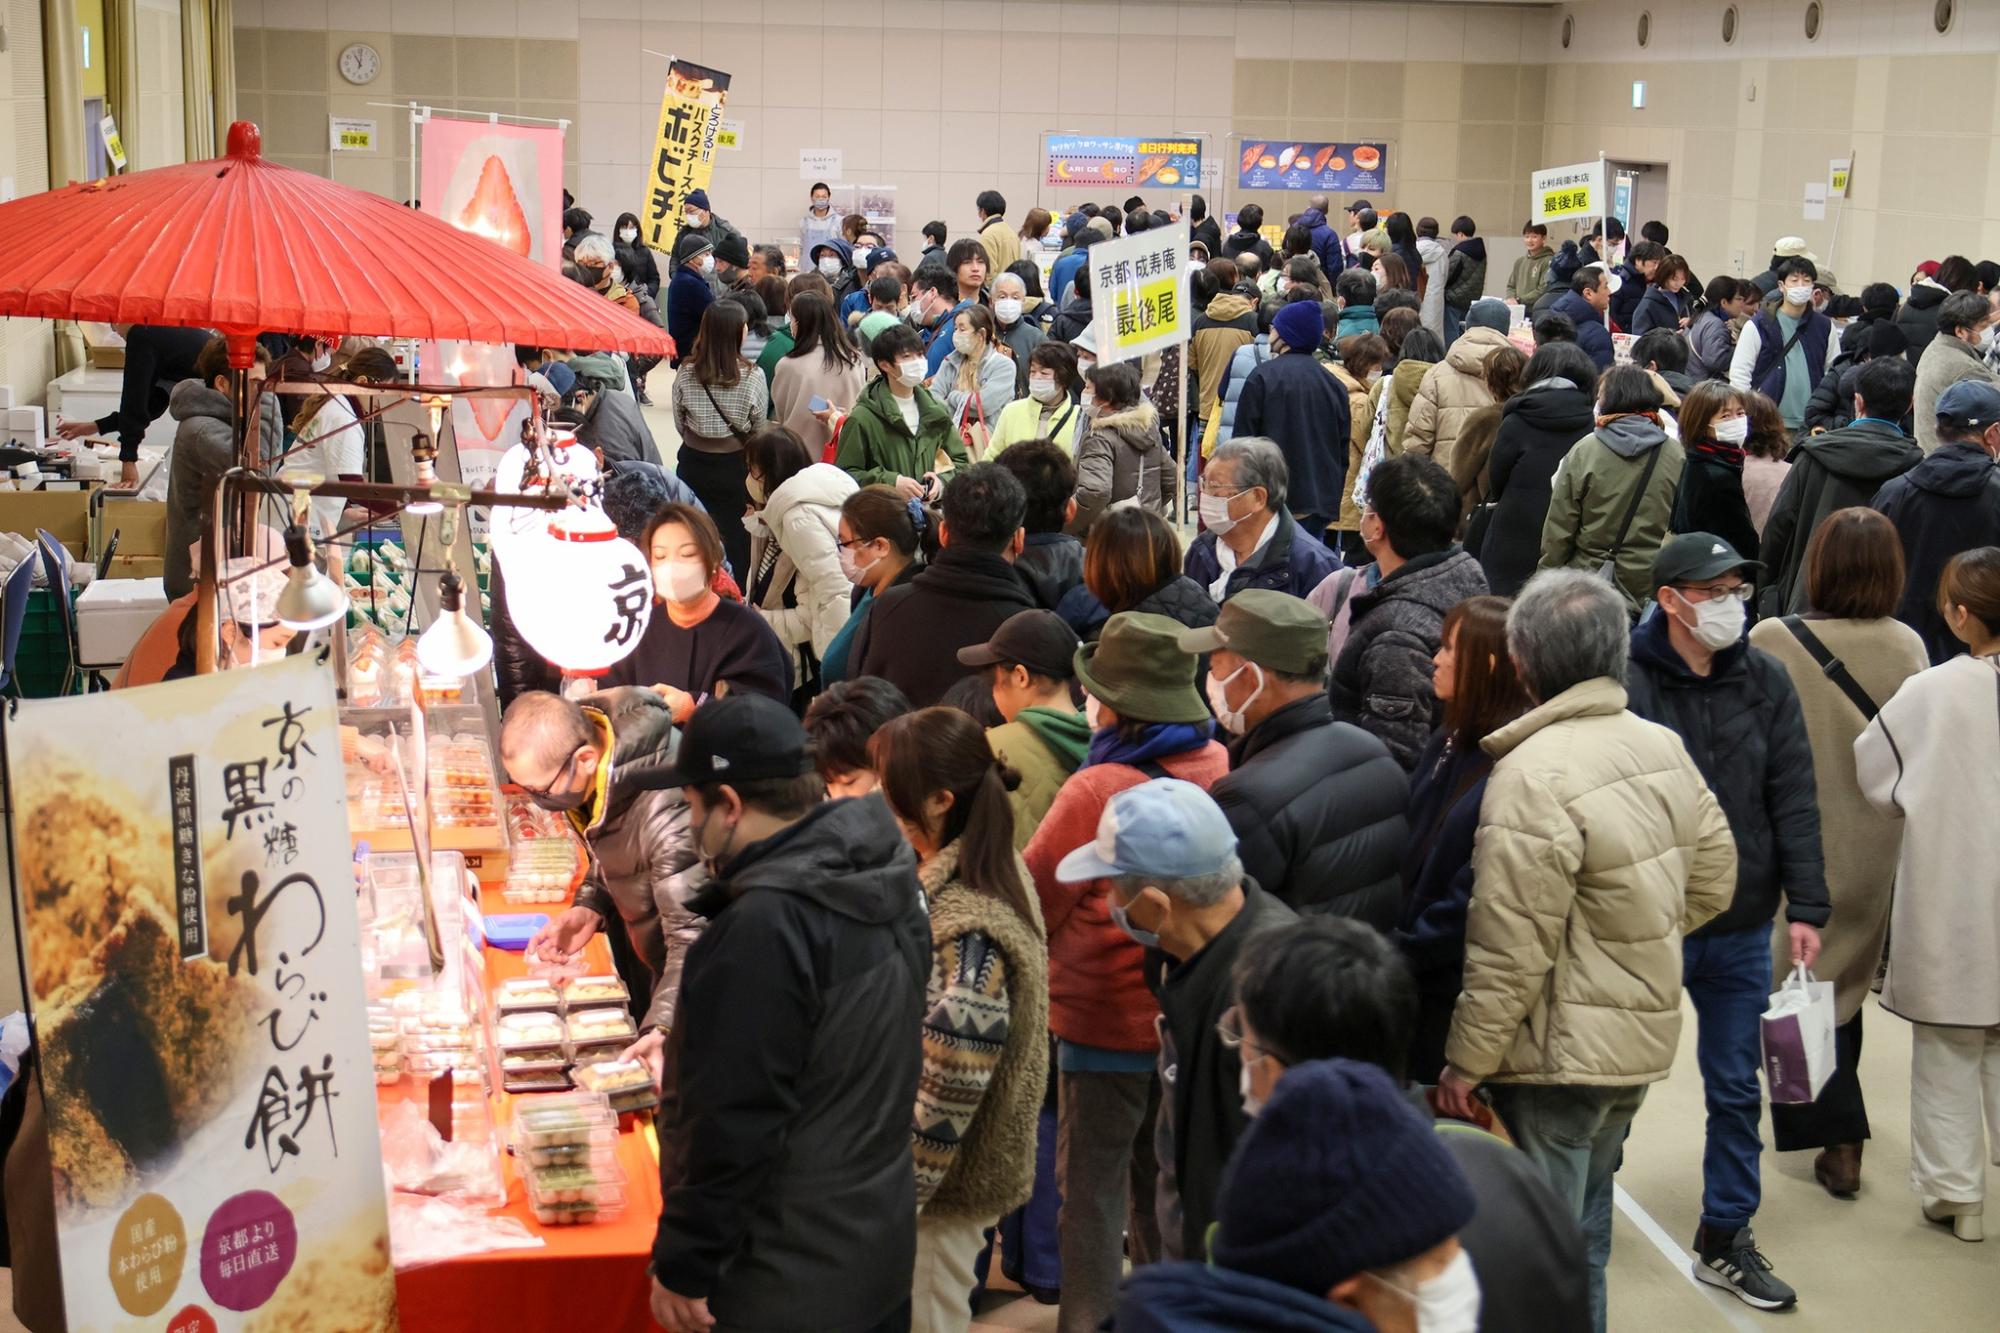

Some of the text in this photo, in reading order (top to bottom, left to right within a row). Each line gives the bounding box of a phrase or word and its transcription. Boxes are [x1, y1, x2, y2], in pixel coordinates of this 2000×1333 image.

[652, 103, 693, 243] ボビチー
[1544, 192, 1587, 212] 最後尾
[1099, 247, 1177, 288] 京都 成寿庵
[1116, 290, 1176, 337] 最後尾
[604, 564, 648, 646] 京
[118, 1233, 178, 1275] 本わらび粉
[218, 1220, 276, 1256] 京都より
[219, 1243, 280, 1279] 毎日直送
